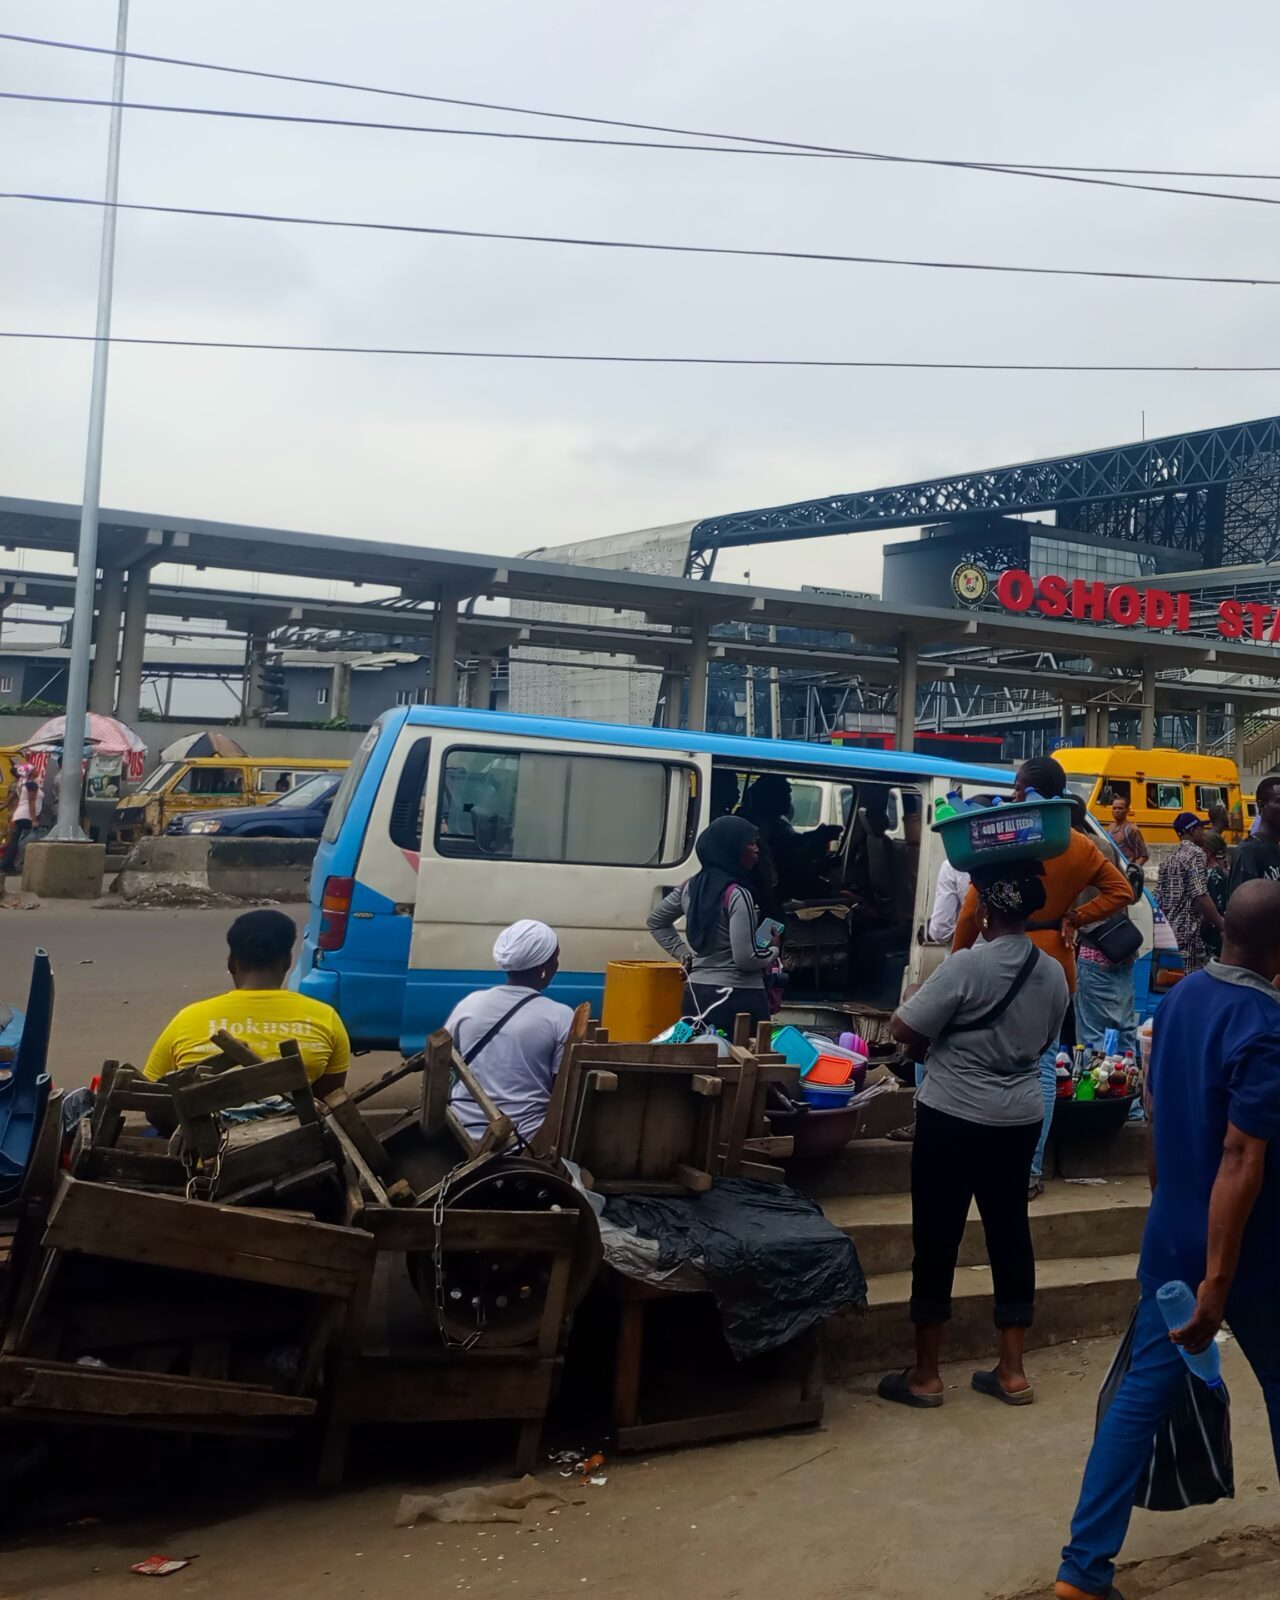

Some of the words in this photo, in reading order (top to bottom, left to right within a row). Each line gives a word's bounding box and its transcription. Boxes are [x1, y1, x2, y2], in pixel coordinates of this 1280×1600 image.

[997, 569, 1190, 632] OSHODI
[982, 823, 996, 835] GOD
[996, 820, 1004, 833] OF
[1004, 819, 1016, 832] ALL
[208, 1017, 313, 1035] Hokusai
